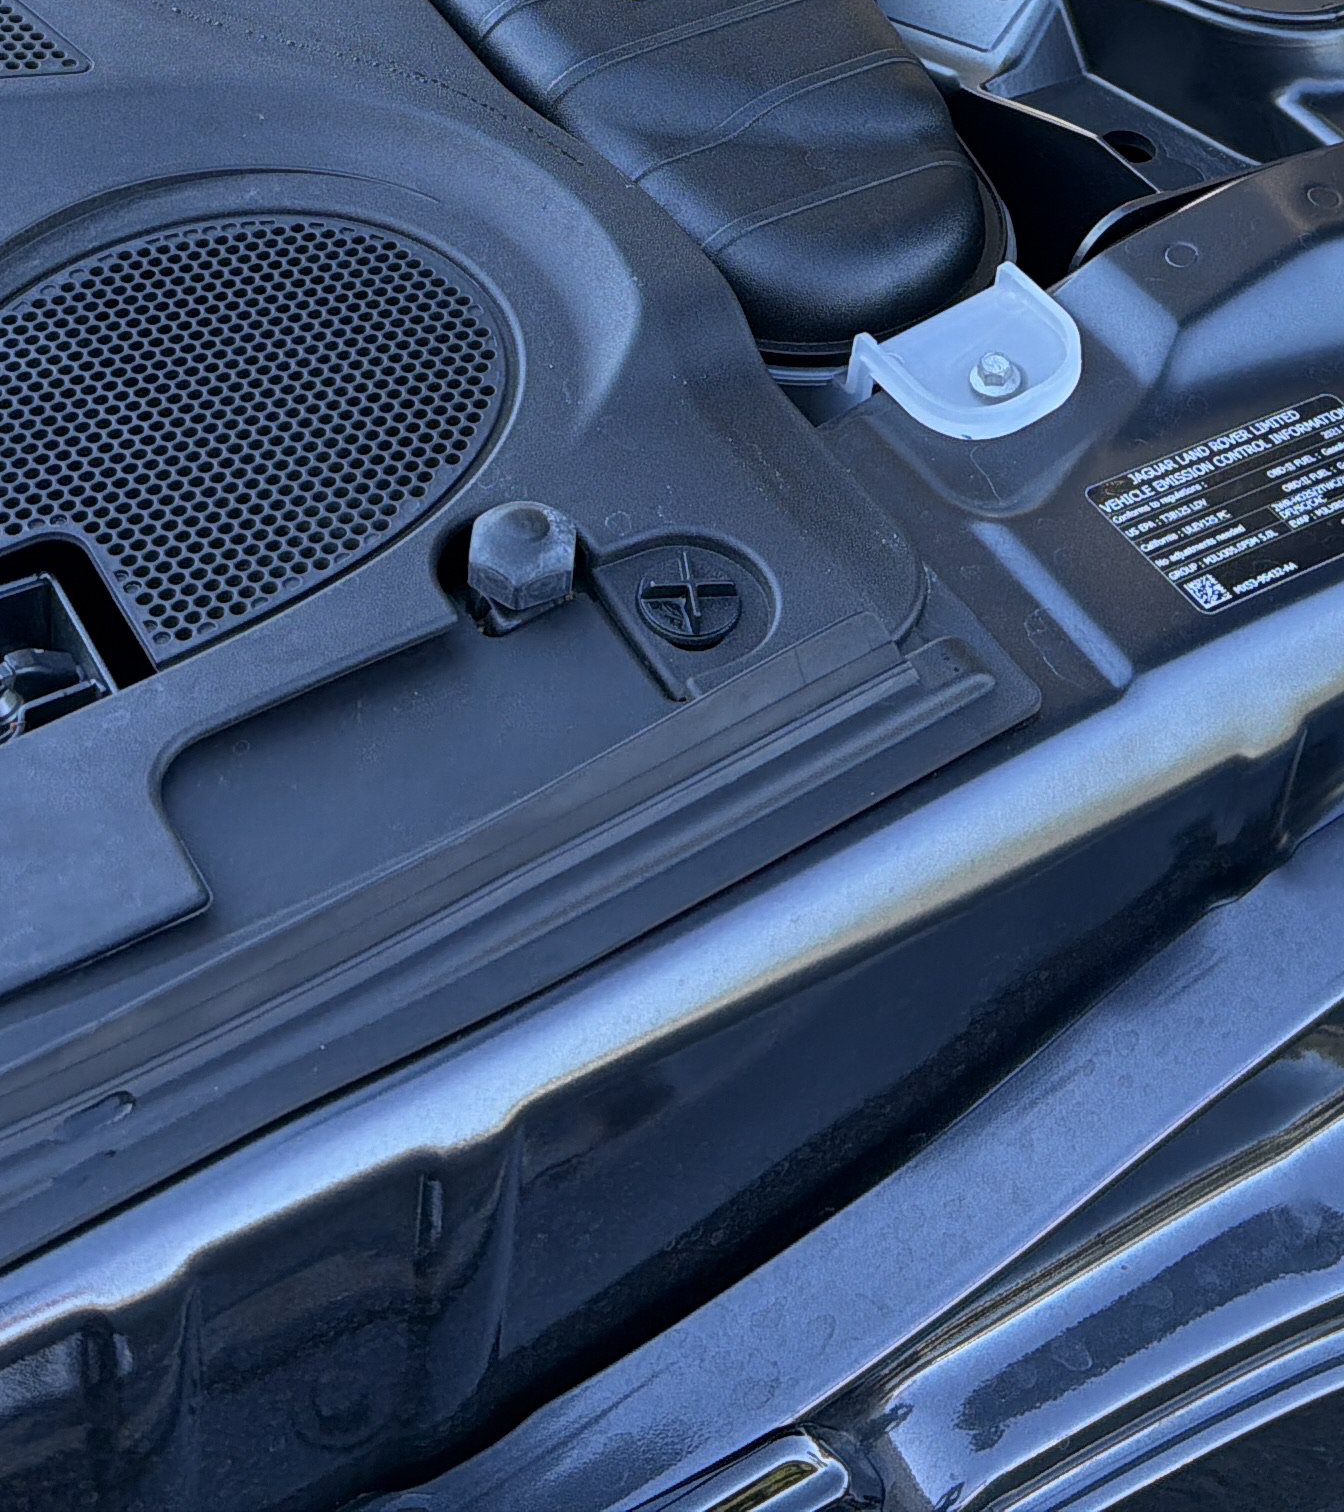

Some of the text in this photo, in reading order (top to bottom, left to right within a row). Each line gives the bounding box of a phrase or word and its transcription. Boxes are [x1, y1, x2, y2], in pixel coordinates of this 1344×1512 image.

[1127, 409, 1301, 486] JAGUAR LAND ROVER LIMITED
[1293, 453, 1318, 470] FUEL
[1098, 485, 1157, 513] VEHICLE
[1152, 460, 1216, 492] EMISSION
[1212, 438, 1273, 468] CONTROL
[1309, 468, 1333, 484] FUEL
[1149, 500, 1161, 509] to
[1159, 483, 1202, 505] regulations
[1125, 528, 1140, 538] US
[1137, 520, 1158, 533] EPA
[1215, 523, 1247, 543] needed
[1168, 562, 1198, 581] GROUP
